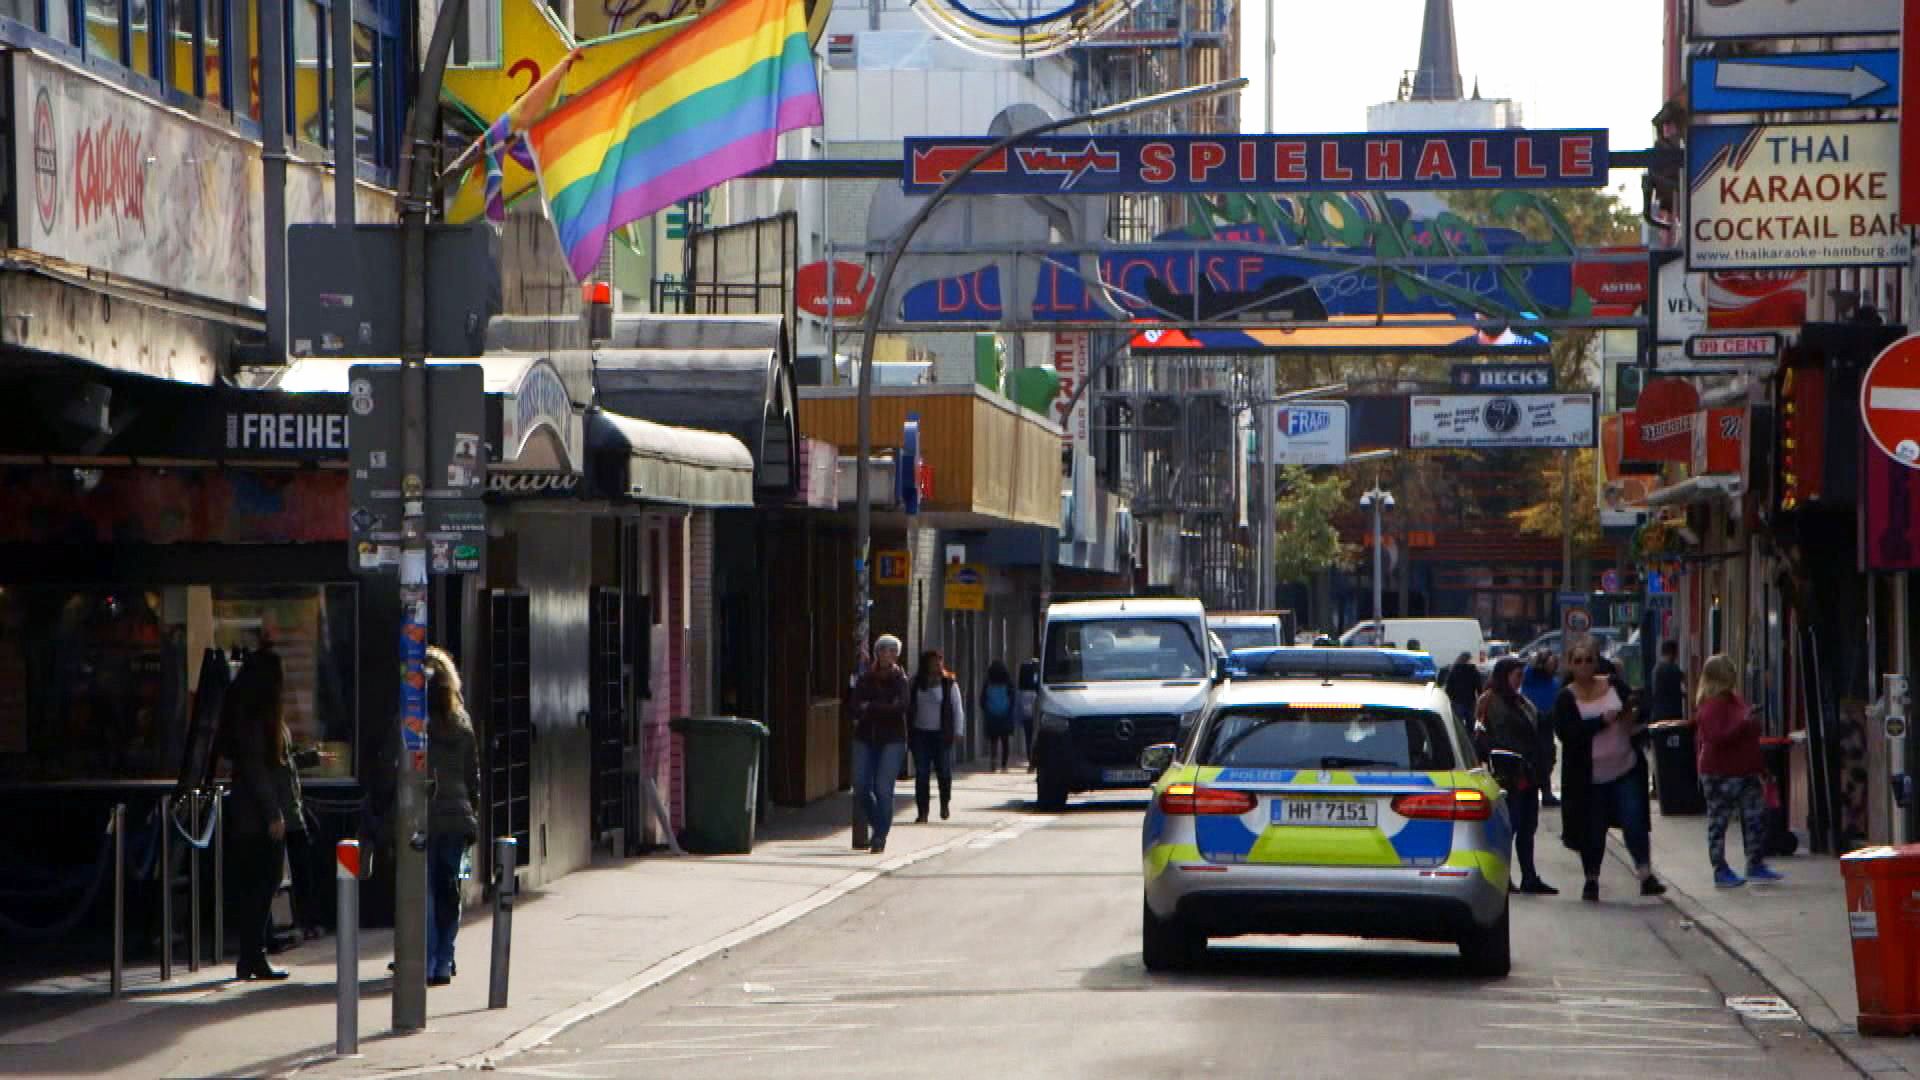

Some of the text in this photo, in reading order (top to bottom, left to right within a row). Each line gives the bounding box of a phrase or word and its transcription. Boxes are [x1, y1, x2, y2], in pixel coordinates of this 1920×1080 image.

[1139, 136, 1594, 183] SPIELHALLE
[1765, 135, 1850, 165] THAI
[1719, 172, 1888, 205] KARAOKE
[1694, 216, 1840, 243] COCKTAIL
[1600, 282, 1642, 293] ASTRA
[1722, 339, 1769, 353] CENT
[1480, 370, 1549, 385] BECK'S
[1288, 803, 1369, 821] HH 7151
